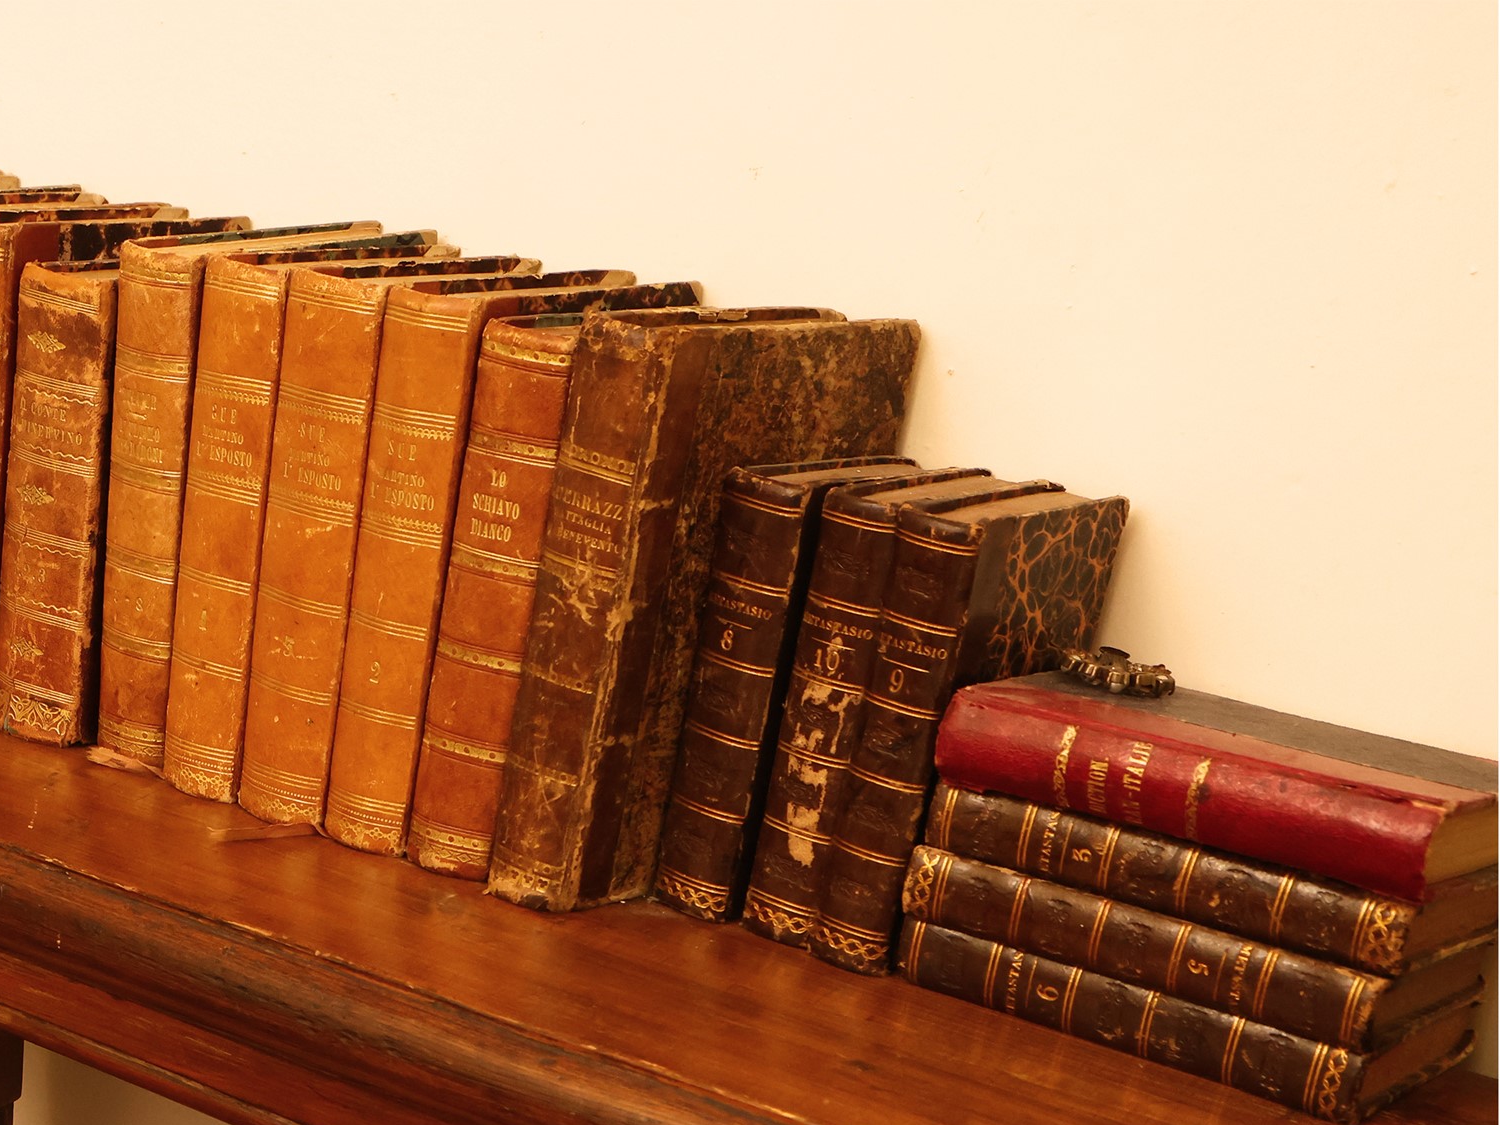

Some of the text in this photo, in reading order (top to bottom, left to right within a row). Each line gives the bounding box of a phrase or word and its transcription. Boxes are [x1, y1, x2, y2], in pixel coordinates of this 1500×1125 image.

[31, 401, 67, 422] CONTE
[299, 422, 326, 443] SUE
[388, 439, 417, 461] SUE
[298, 467, 342, 491] ESPOSTO
[380, 467, 425, 488] ARTINO
[490, 469, 507, 488] LO
[384, 487, 435, 511] ESPOSTO
[472, 493, 520, 520] SCHIAVO
[470, 517, 512, 542] BIANCO
[720, 629, 734, 650] 8
[889, 668, 905, 693] 9
[1187, 958, 1209, 977] 5
